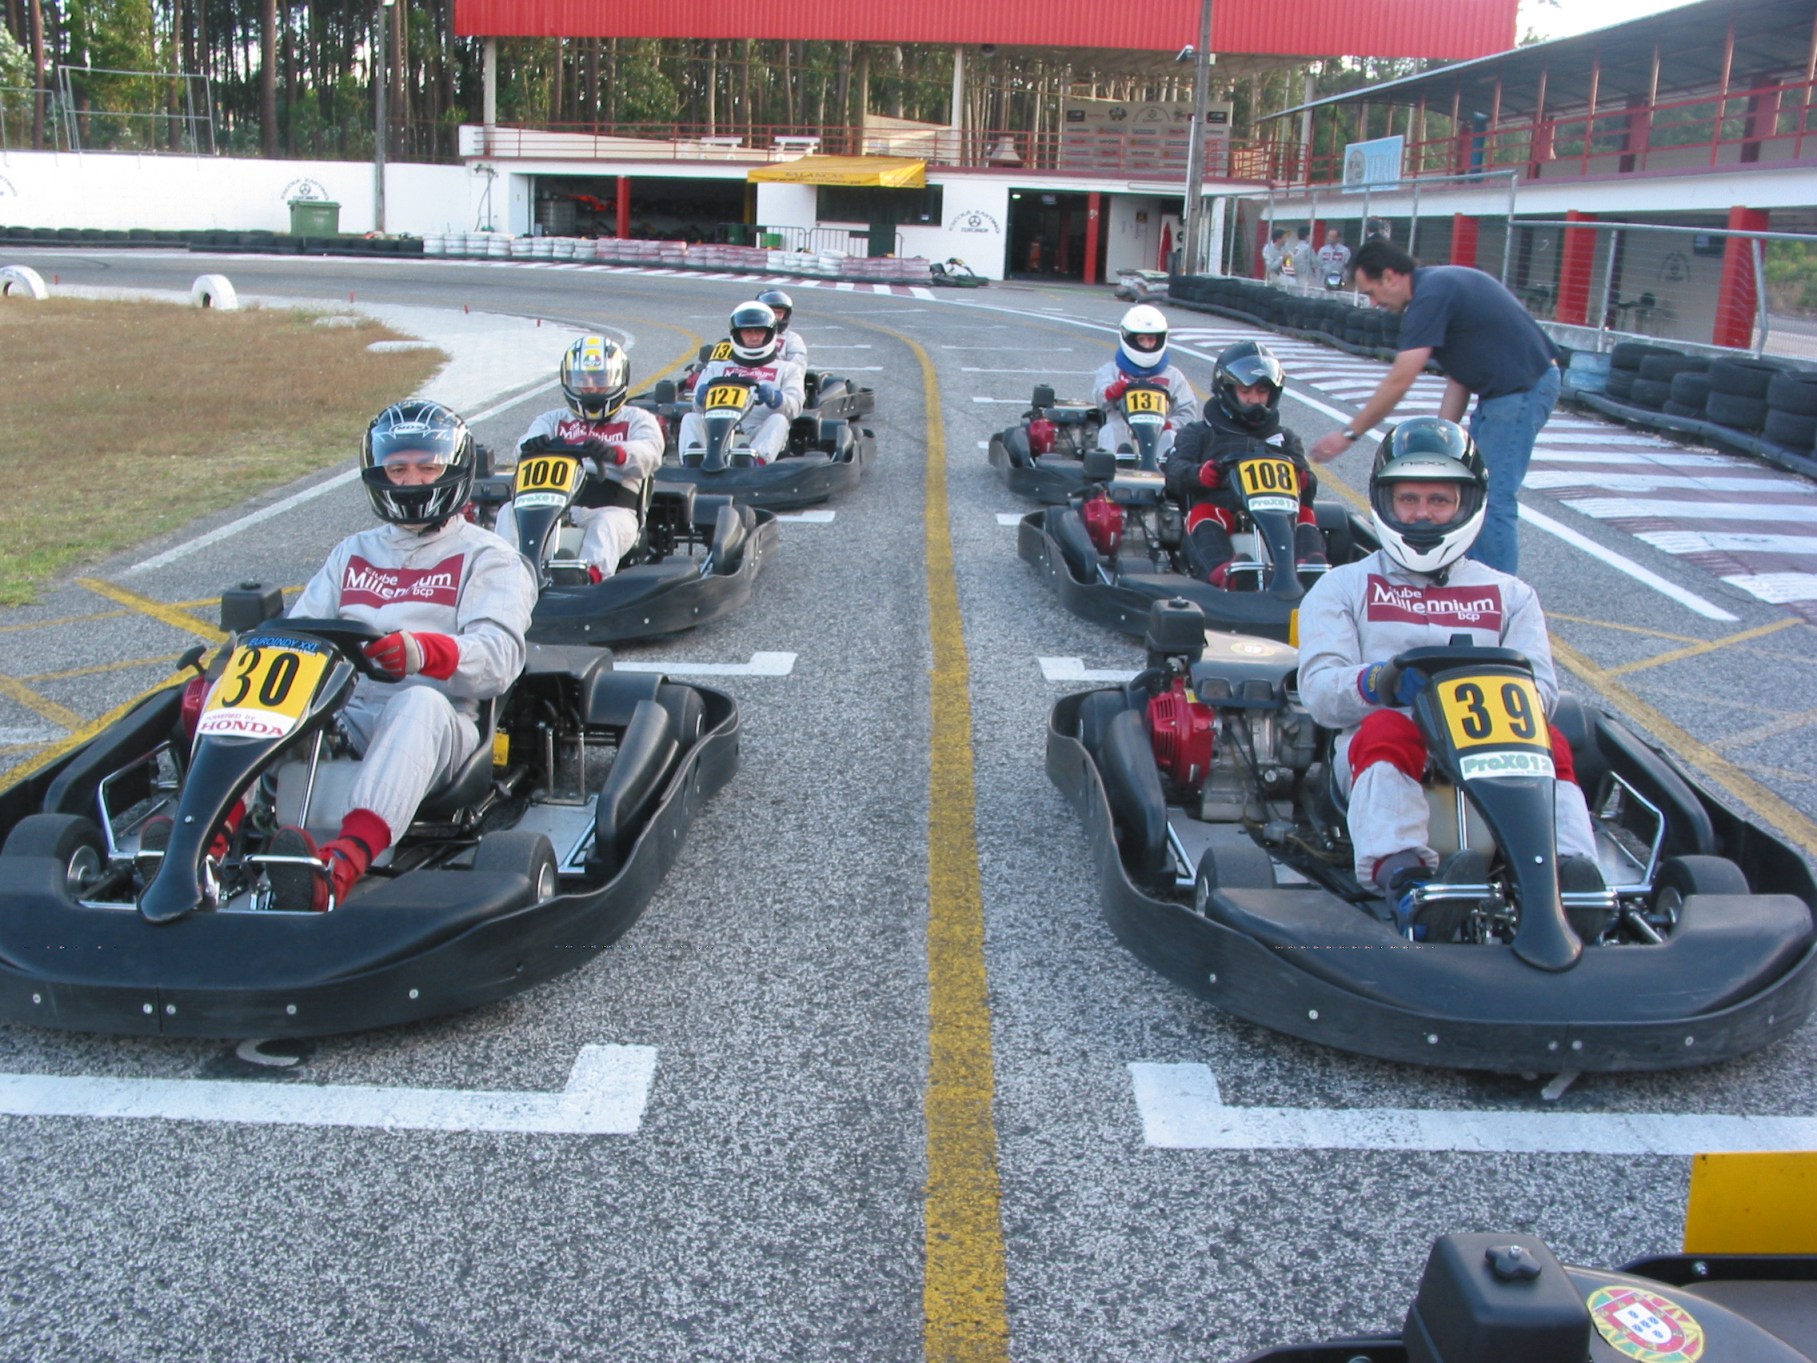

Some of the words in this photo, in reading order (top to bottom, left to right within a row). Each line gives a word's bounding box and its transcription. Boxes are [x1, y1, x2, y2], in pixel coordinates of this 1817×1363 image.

[710, 387, 740, 406] 127
[522, 460, 569, 487] 100
[1244, 462, 1292, 490] 108
[1457, 611, 1480, 622] bcp
[221, 648, 300, 708] 30
[1454, 682, 1536, 739] 39
[201, 720, 284, 736] HONDA
